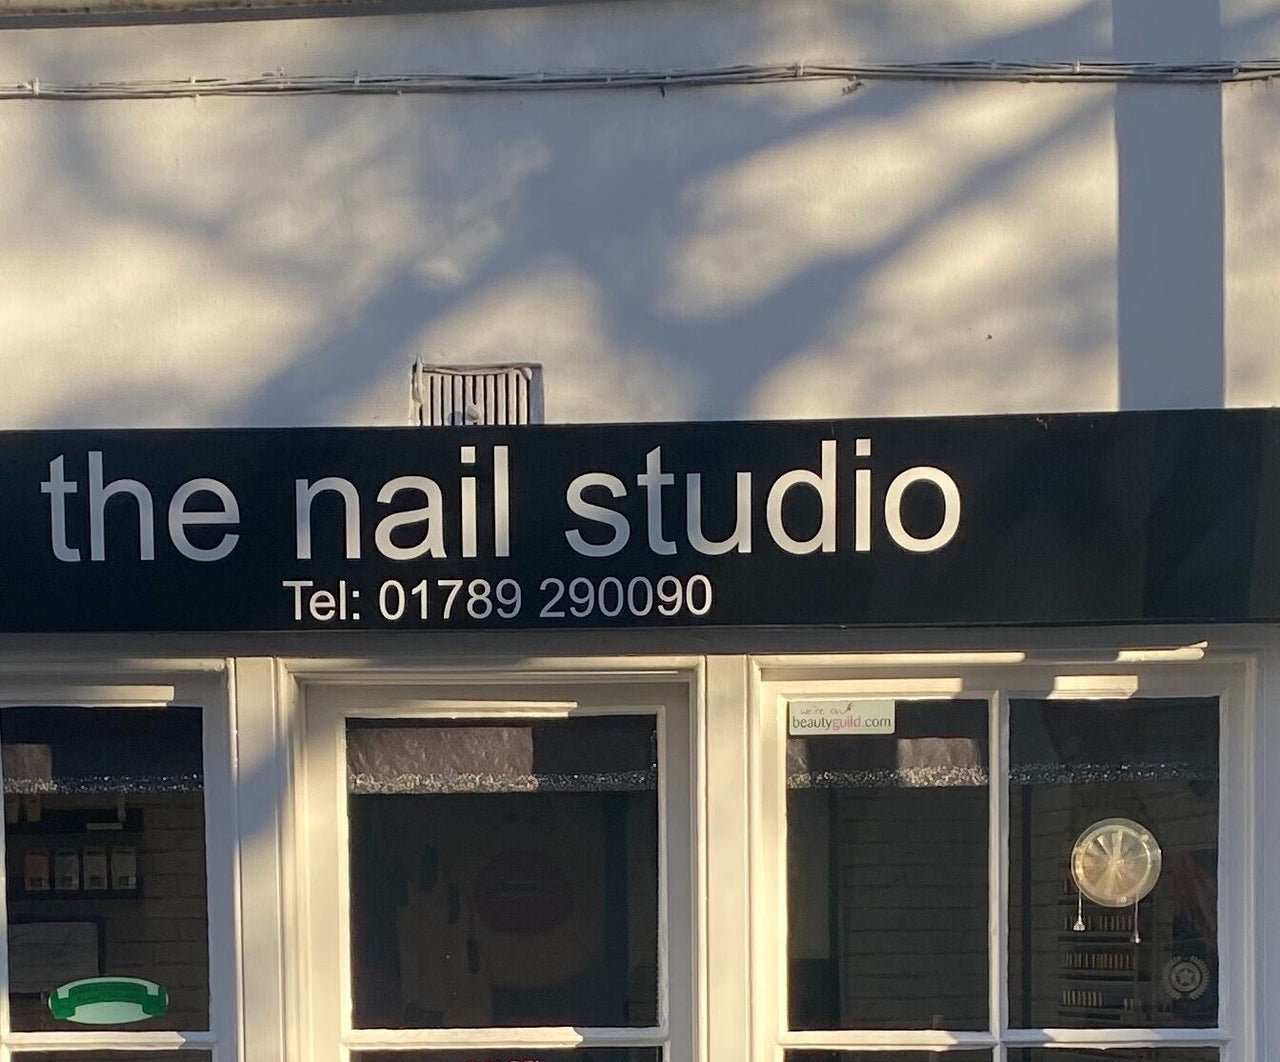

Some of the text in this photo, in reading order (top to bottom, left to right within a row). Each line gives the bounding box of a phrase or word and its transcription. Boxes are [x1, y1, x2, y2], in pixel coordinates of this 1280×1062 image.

[40, 439, 962, 563] the nail studio
[283, 574, 714, 622] Tel: 01789 290090
[792, 715, 891, 731] beautyguild.com
